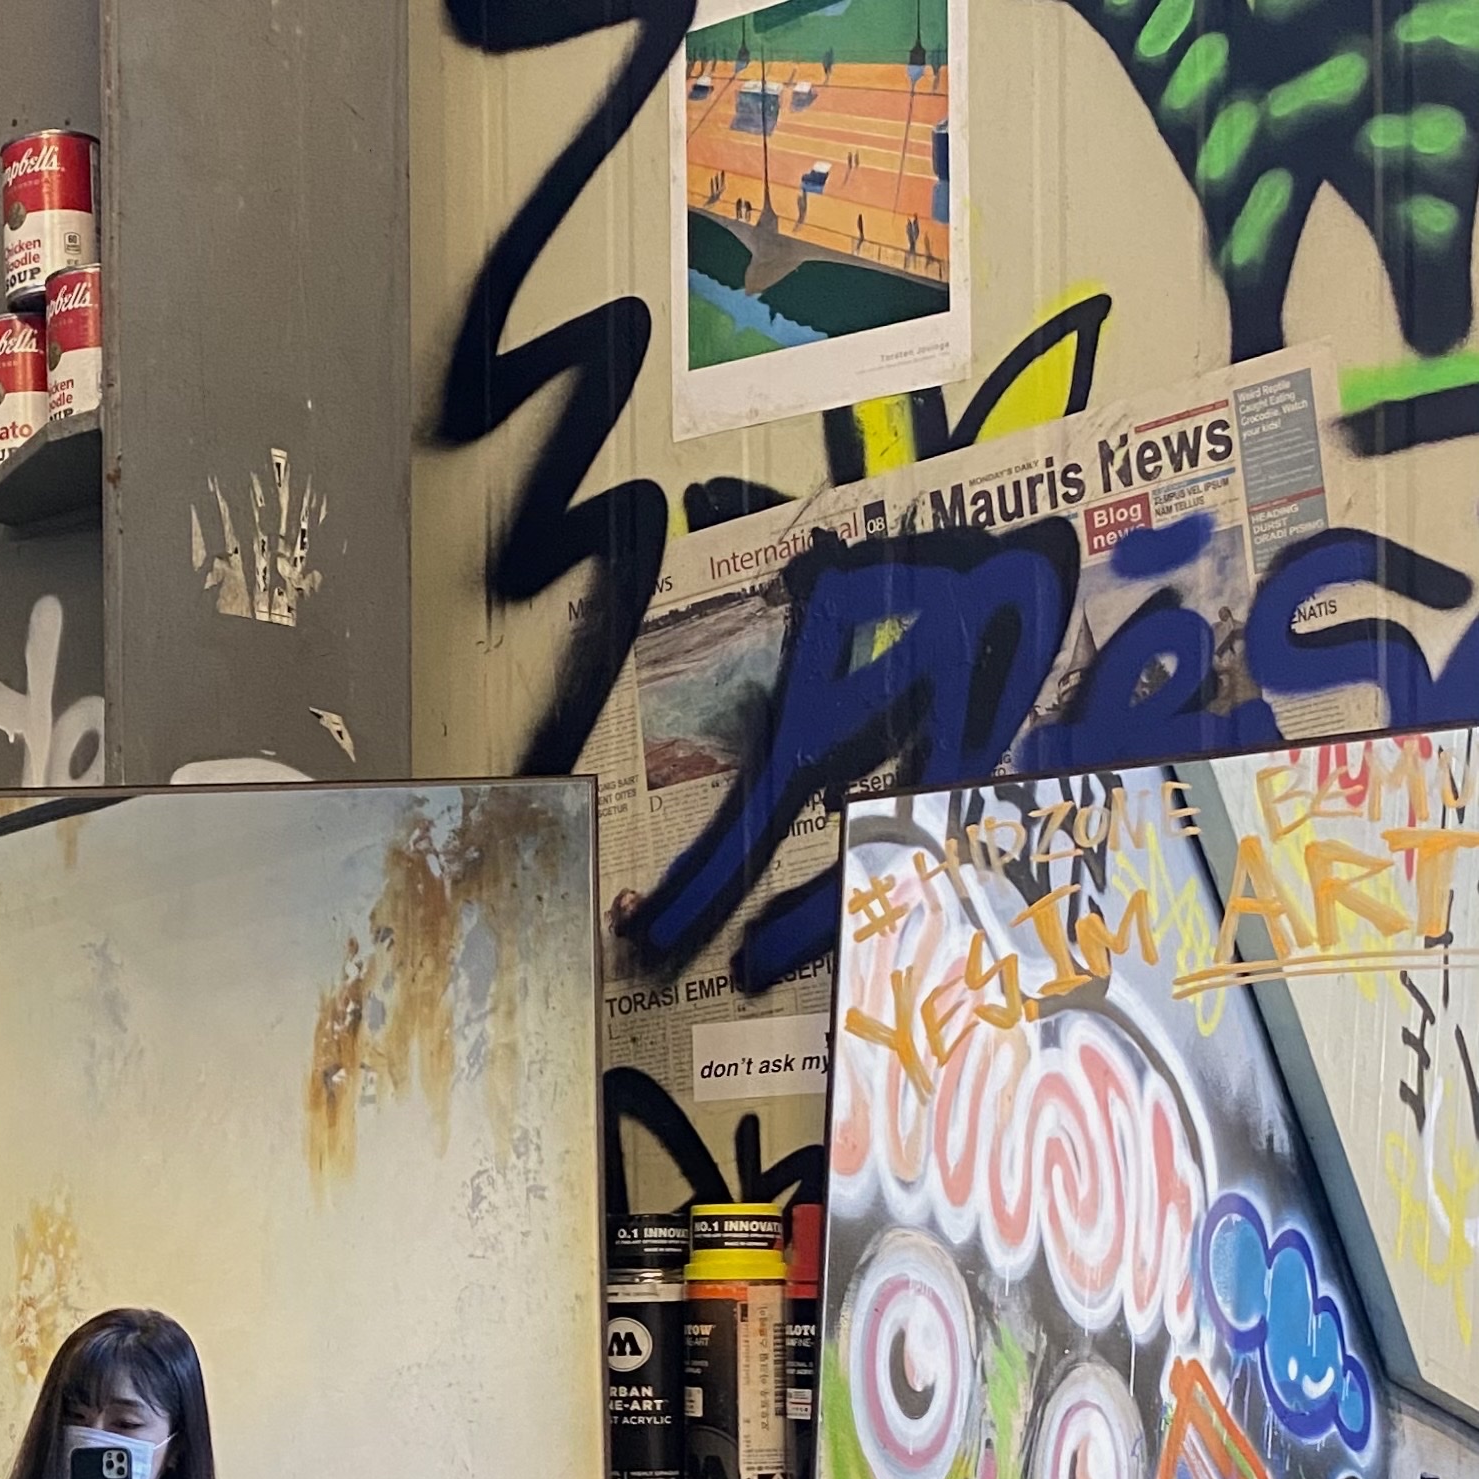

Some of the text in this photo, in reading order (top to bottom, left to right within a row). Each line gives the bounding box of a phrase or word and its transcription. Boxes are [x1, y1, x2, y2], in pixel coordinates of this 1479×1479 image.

[929, 456, 1086, 532] Mauris
[1098, 419, 1234, 493] News
[866, 516, 885, 534] 08
[1093, 502, 1144, 530] Blog
[1251, 503, 1299, 525] HEADING
[1214, 826, 1479, 964] ART
[606, 986, 680, 1018] TORASI
[700, 1057, 754, 1079] don't
[759, 1054, 796, 1074] ask
[621, 1415, 672, 1425] ACRYLIC
